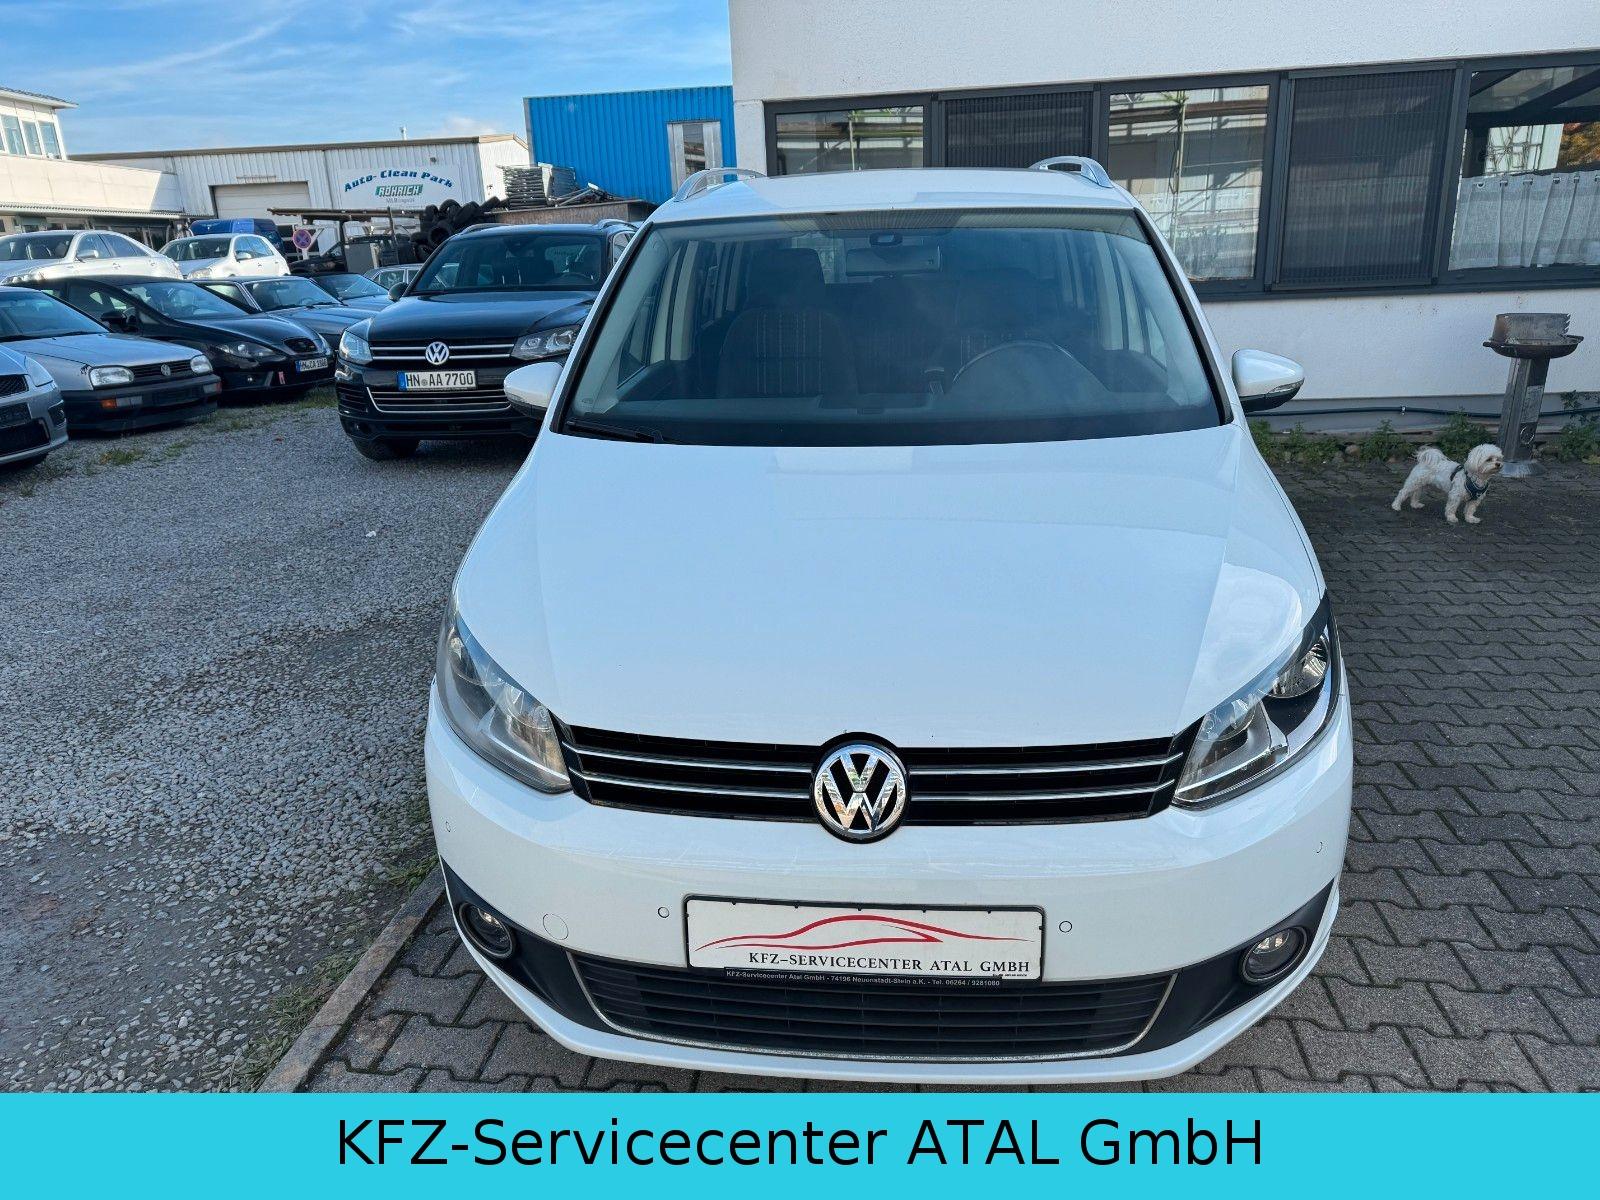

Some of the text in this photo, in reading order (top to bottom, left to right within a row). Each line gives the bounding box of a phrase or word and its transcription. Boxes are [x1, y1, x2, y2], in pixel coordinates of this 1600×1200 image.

[344, 169, 454, 193] Auto- Clean Park
[405, 372, 475, 387] HN AA 7700
[815, 744, 906, 834] VW
[748, 952, 1030, 972] KFZ-SERVICECENTER ATAL GMBH
